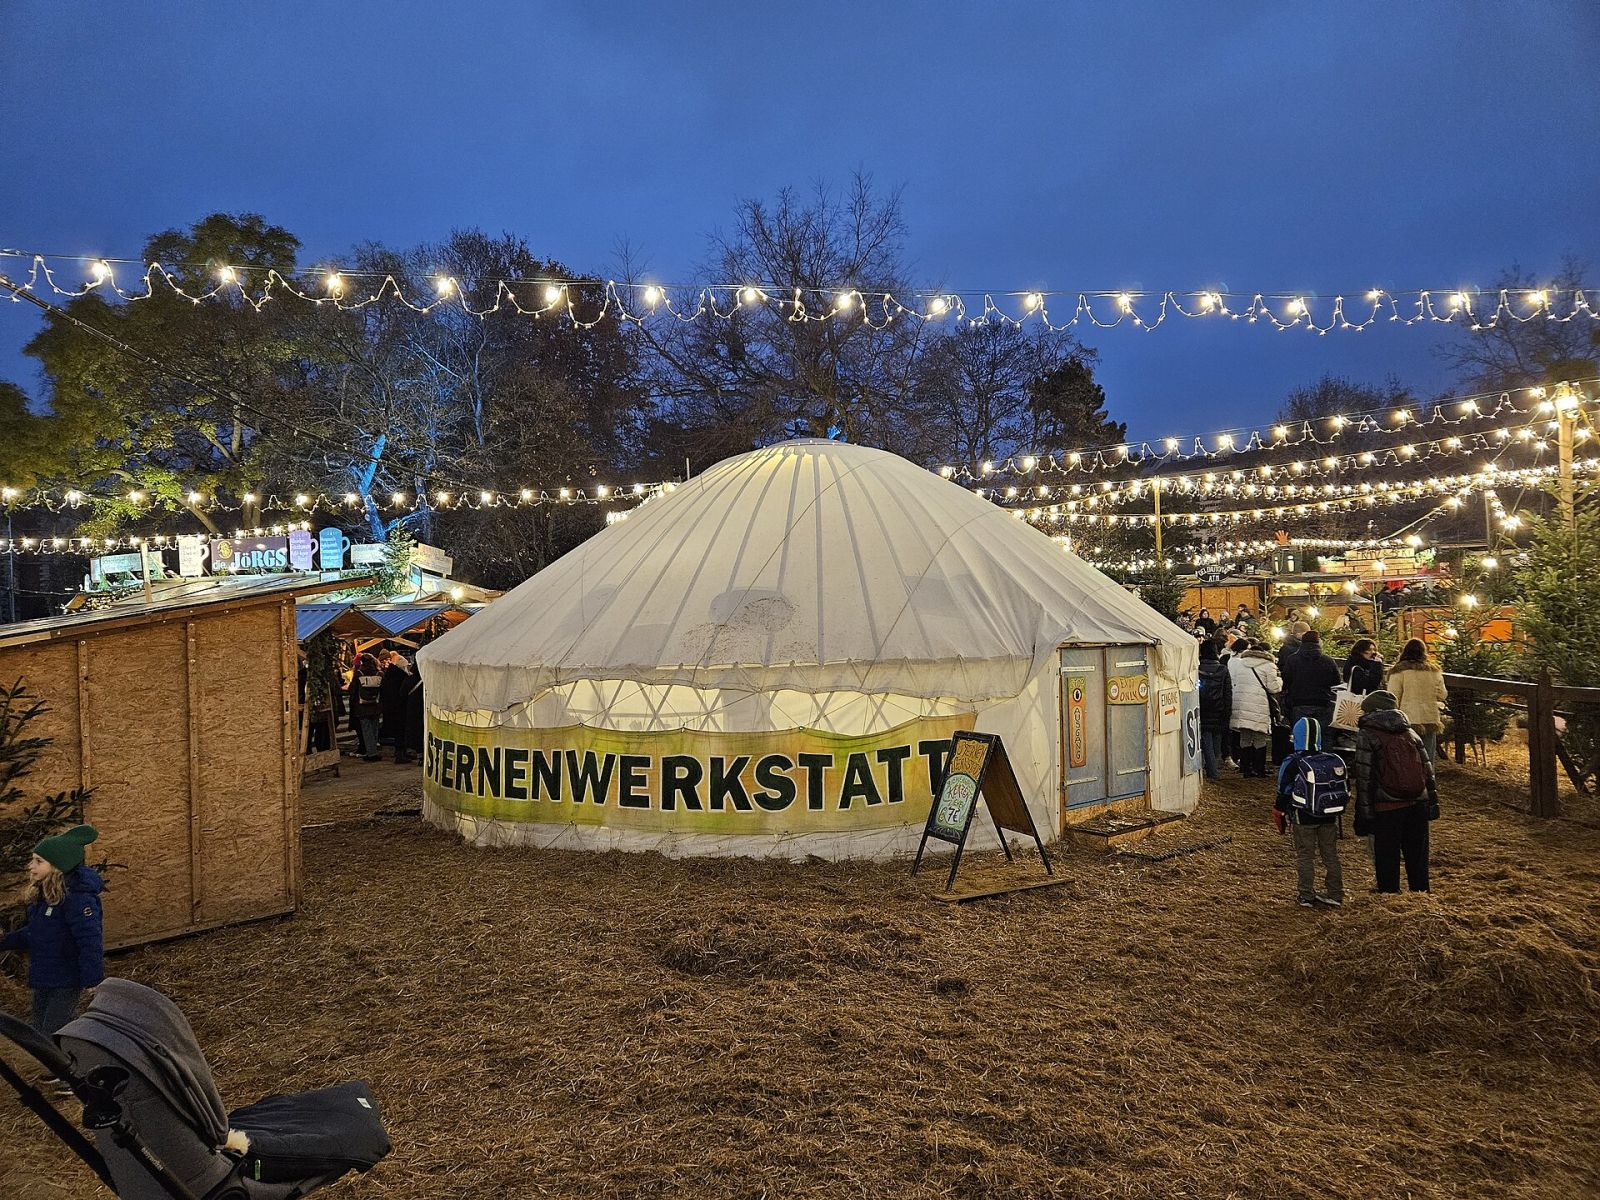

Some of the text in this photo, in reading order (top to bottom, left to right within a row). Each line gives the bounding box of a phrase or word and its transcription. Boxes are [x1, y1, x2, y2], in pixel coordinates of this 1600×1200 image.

[230, 548, 286, 569] JöRGS
[1208, 574, 1220, 582] ATM
[1119, 678, 1135, 689] EXIT
[1120, 690, 1139, 702] ONLY
[427, 731, 951, 810] STERNENWERKSTATT
